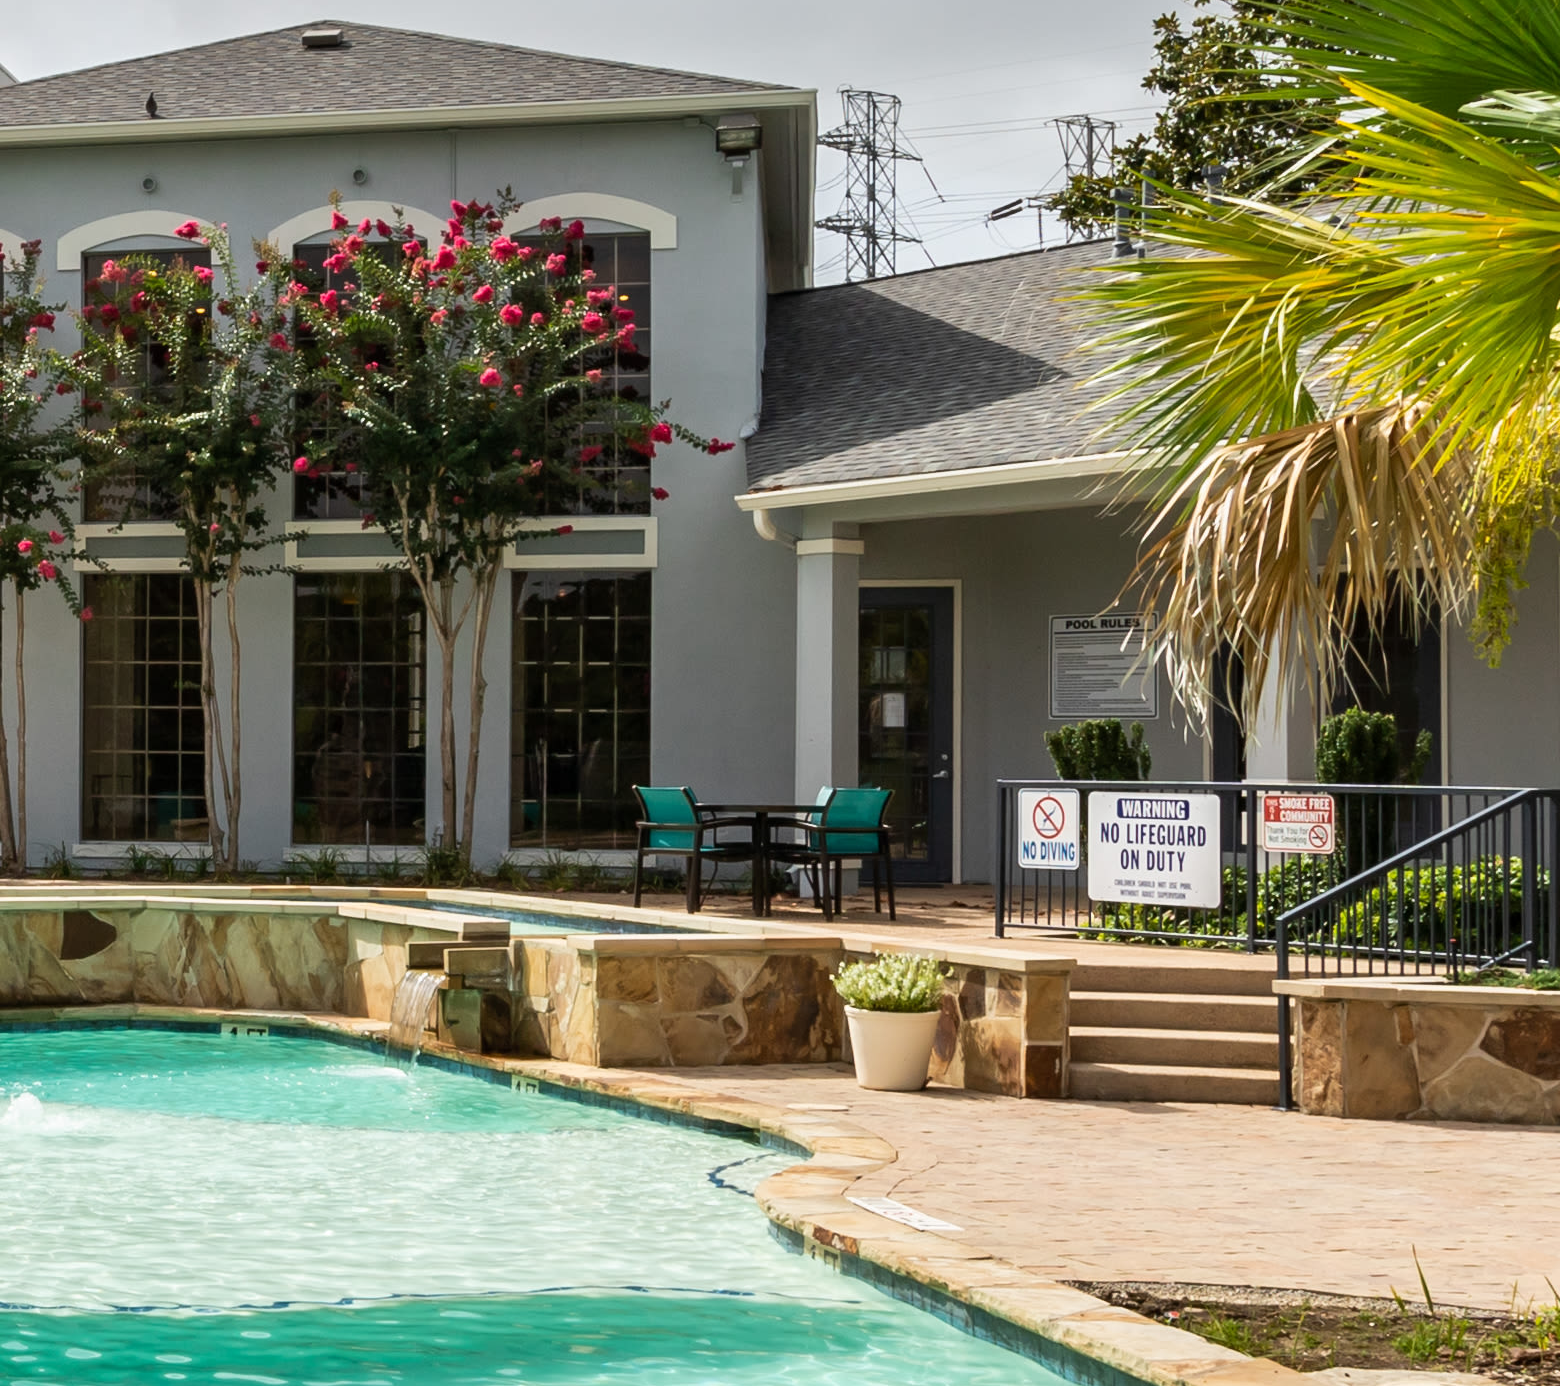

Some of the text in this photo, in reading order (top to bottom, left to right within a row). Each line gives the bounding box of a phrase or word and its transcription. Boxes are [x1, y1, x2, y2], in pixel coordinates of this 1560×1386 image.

[1065, 617, 1141, 630] POOL RULES
[1121, 799, 1186, 819] WARNING
[1279, 797, 1331, 810] SMOKE FREE
[1280, 810, 1330, 823] COMMUNITY
[1100, 822, 1207, 847] NO LIFEGUARD
[1023, 841, 1075, 862] NO DIVING
[1120, 848, 1186, 872] ON DUTY
